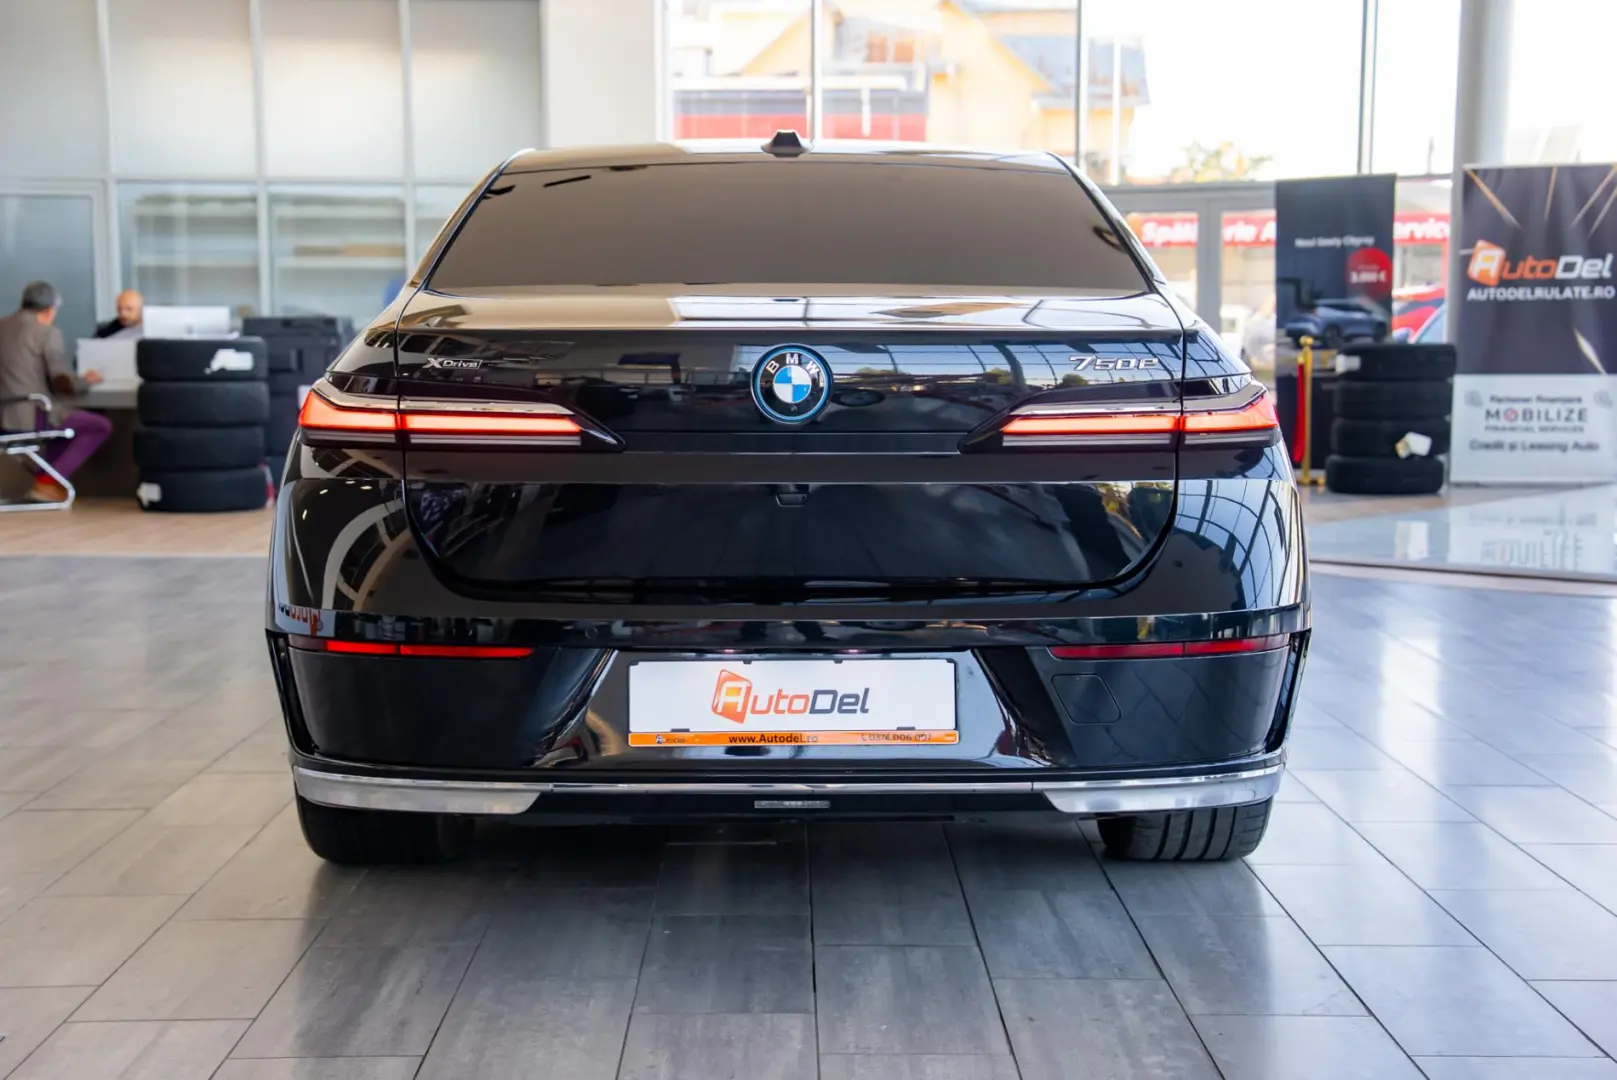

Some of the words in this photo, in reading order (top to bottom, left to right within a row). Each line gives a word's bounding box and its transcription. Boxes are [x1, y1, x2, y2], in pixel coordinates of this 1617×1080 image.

[1467, 240, 1614, 287] AutoDel
[1467, 285, 1615, 301] AUTODELRULATE.RO
[766, 353, 820, 375] BMW
[1485, 408, 1588, 422] MOBILIZE
[711, 669, 870, 724] AutoDel
